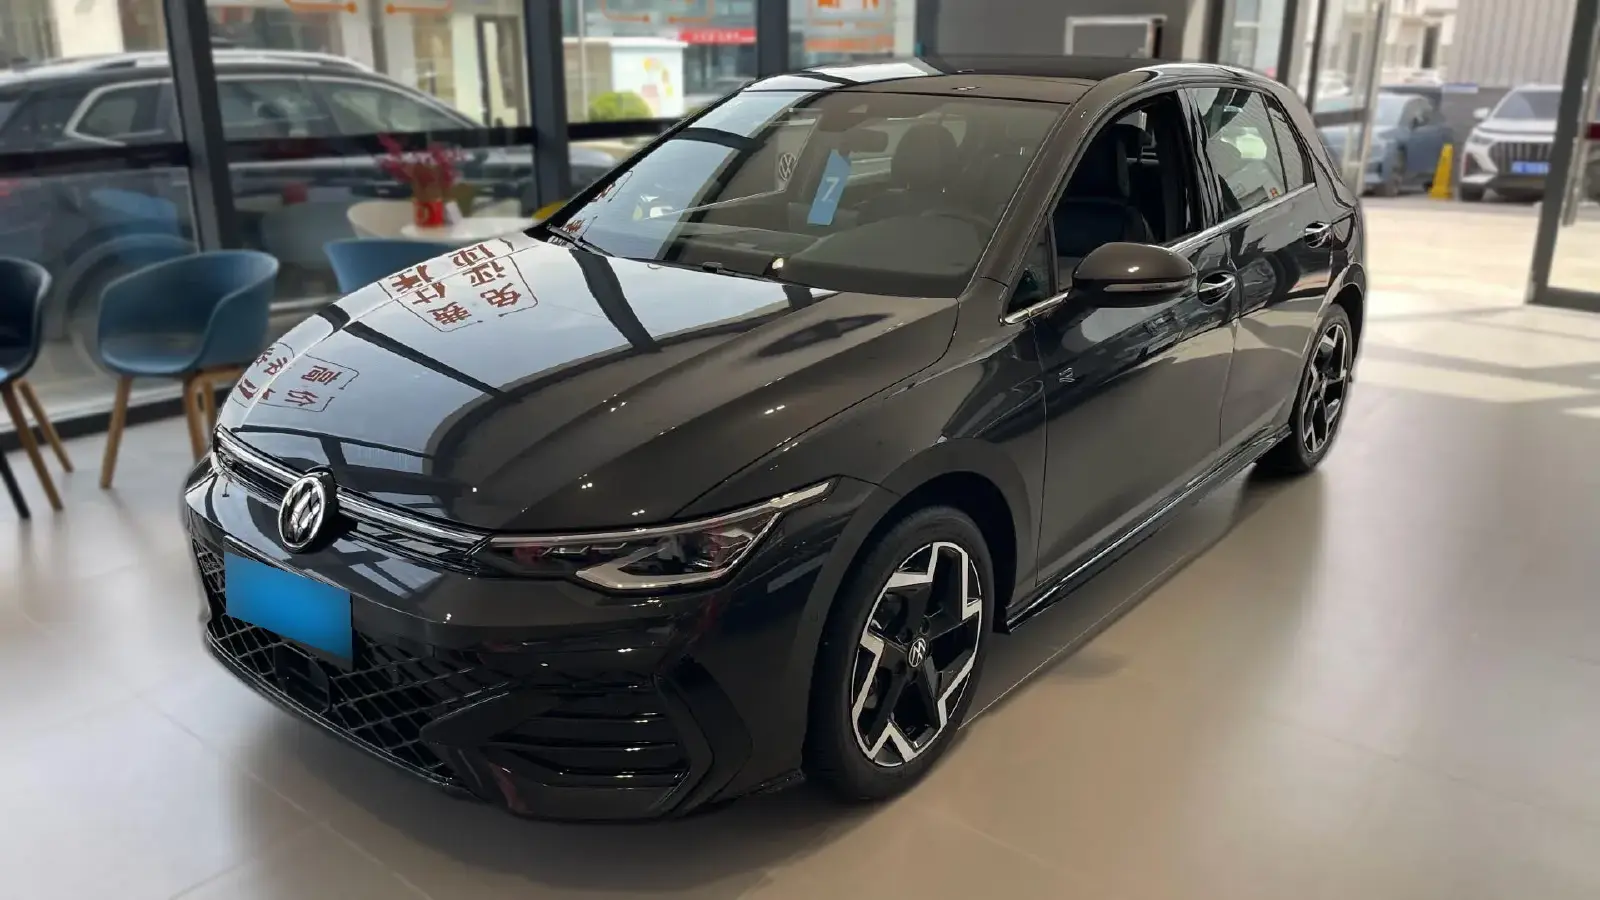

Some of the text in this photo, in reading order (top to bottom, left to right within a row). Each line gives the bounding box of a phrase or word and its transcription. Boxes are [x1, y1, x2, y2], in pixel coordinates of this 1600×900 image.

[821, 177, 840, 202] 7
[426, 282, 522, 326] 免费
[284, 364, 343, 407] 高价
